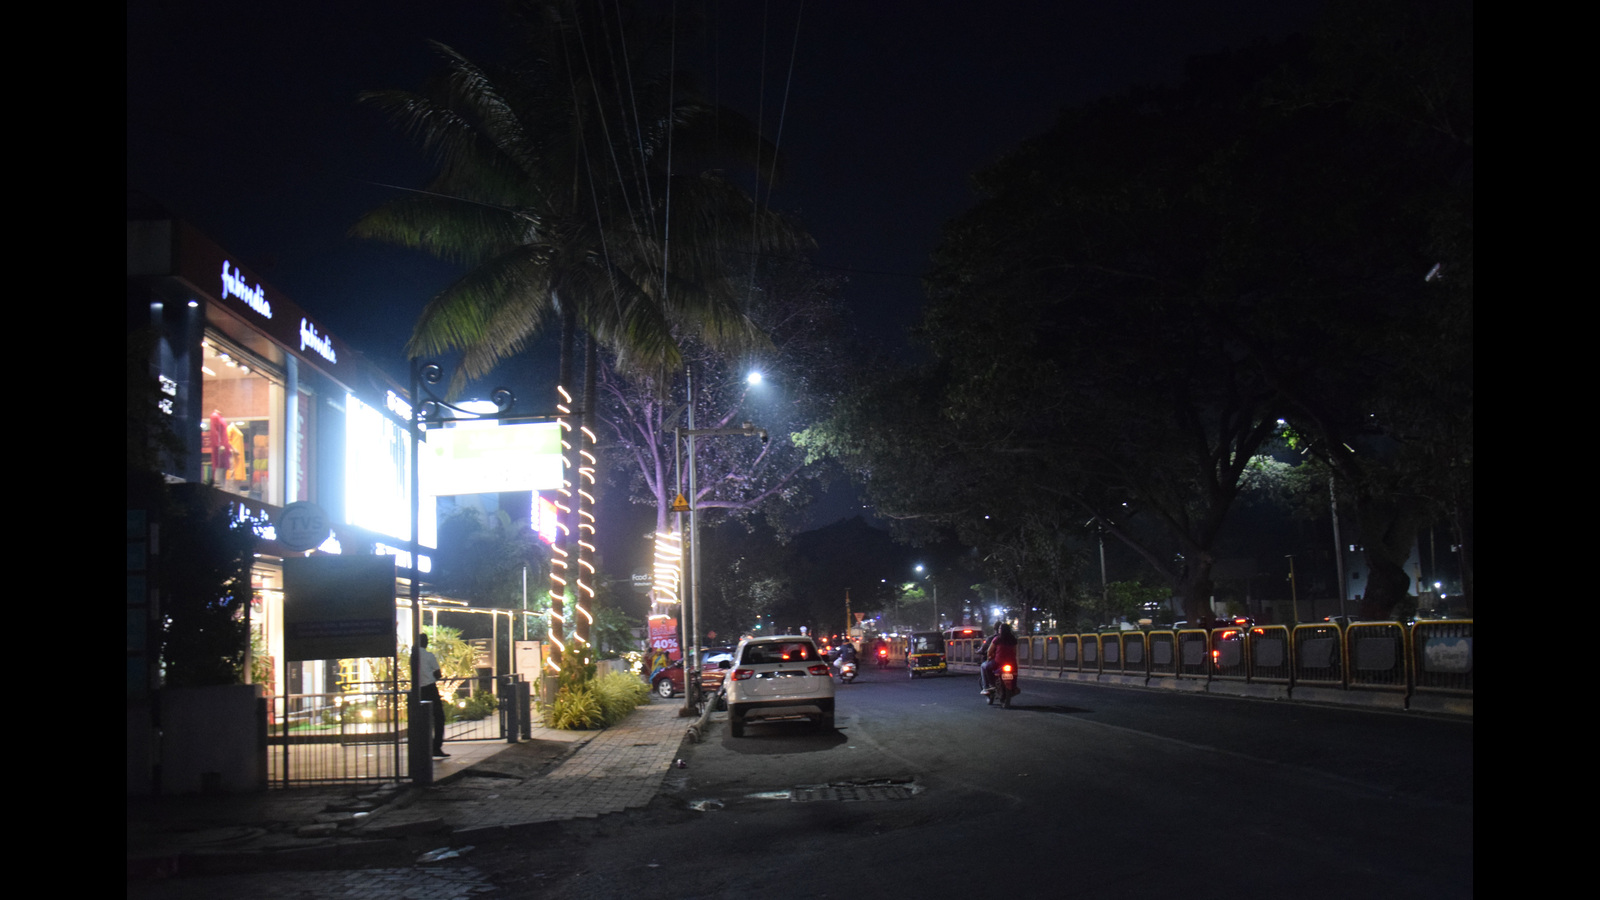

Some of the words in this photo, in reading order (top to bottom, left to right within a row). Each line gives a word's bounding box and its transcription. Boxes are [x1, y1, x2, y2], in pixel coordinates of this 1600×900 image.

[221, 260, 272, 319] fabindia
[300, 317, 337, 364] fabindia
[290, 515, 323, 530] TVS
[653, 638, 678, 649] 40%
